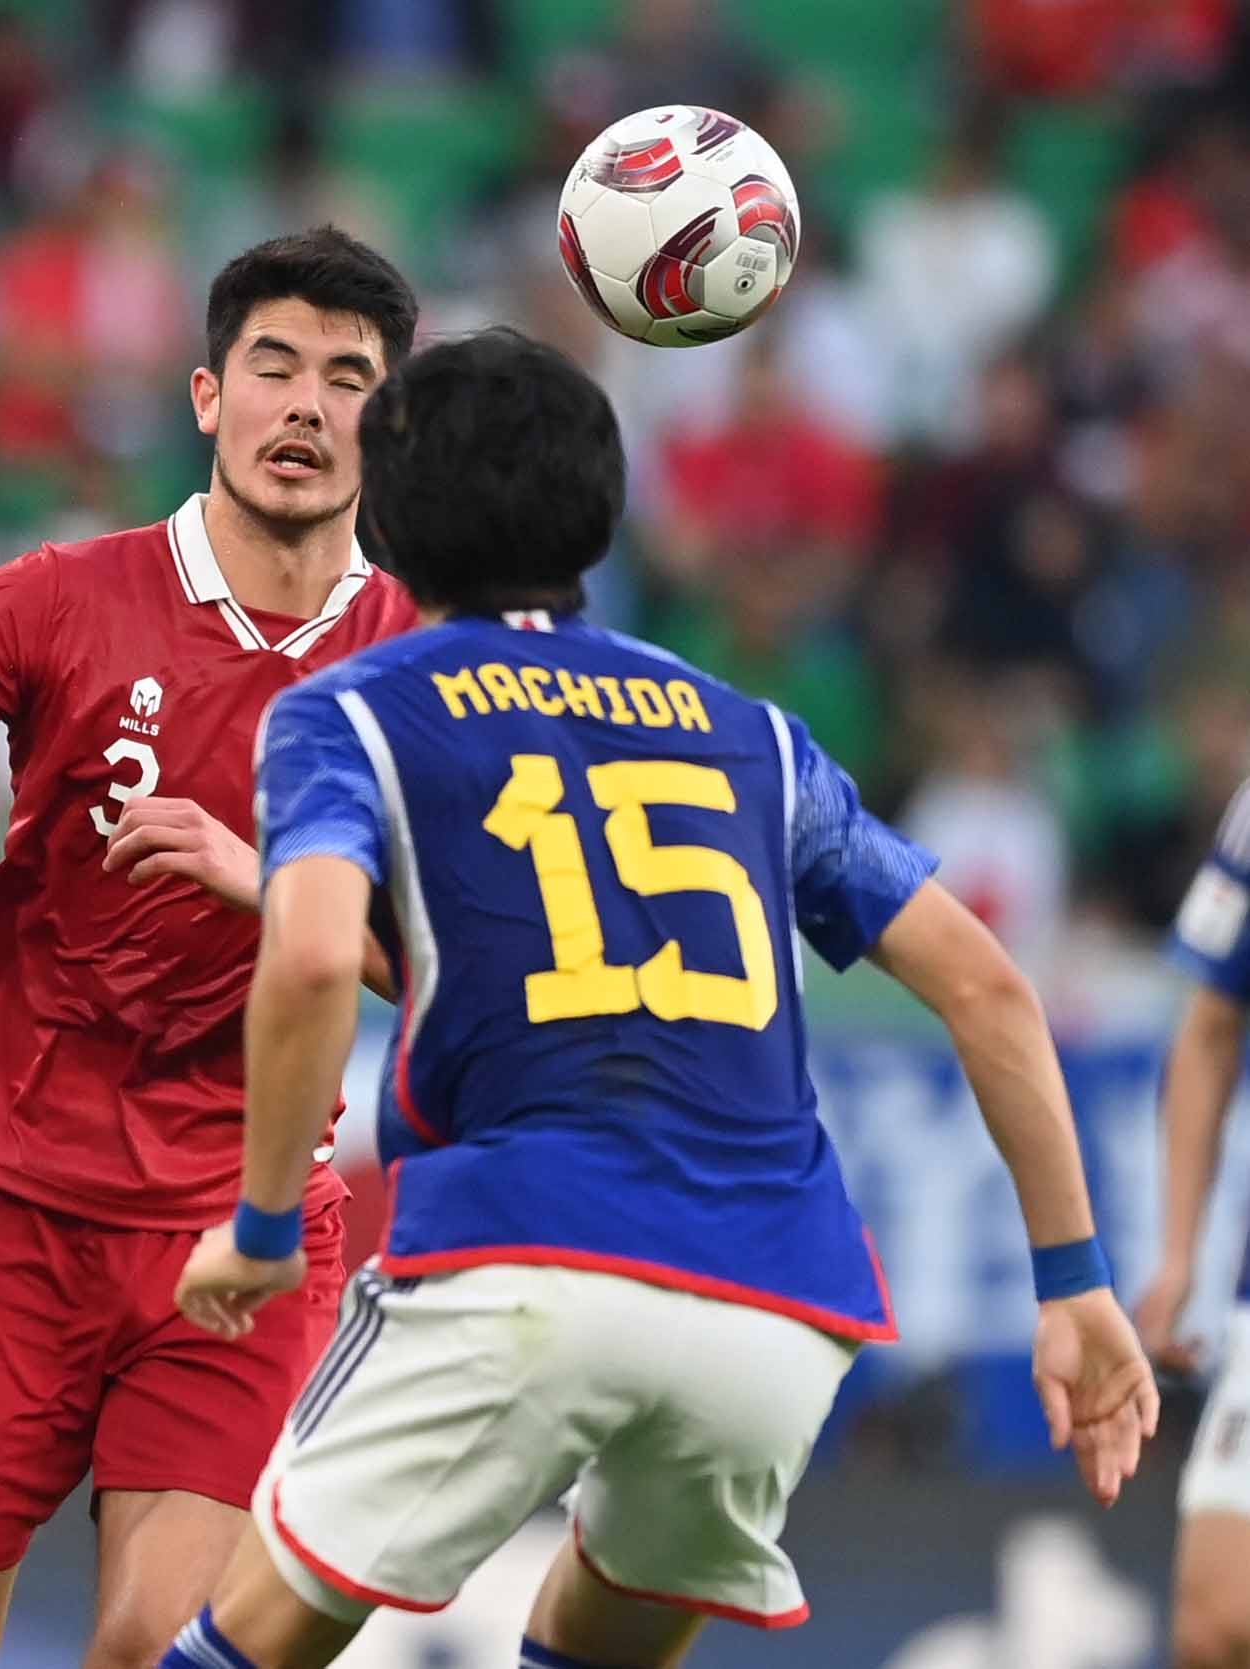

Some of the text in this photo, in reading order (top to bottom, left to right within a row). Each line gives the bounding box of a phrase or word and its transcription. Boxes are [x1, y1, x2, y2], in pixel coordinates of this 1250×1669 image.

[119, 715, 160, 737] MILLS
[431, 662, 712, 734] MACHIDA
[89, 738, 161, 837] 3
[483, 754, 778, 1031] 15
